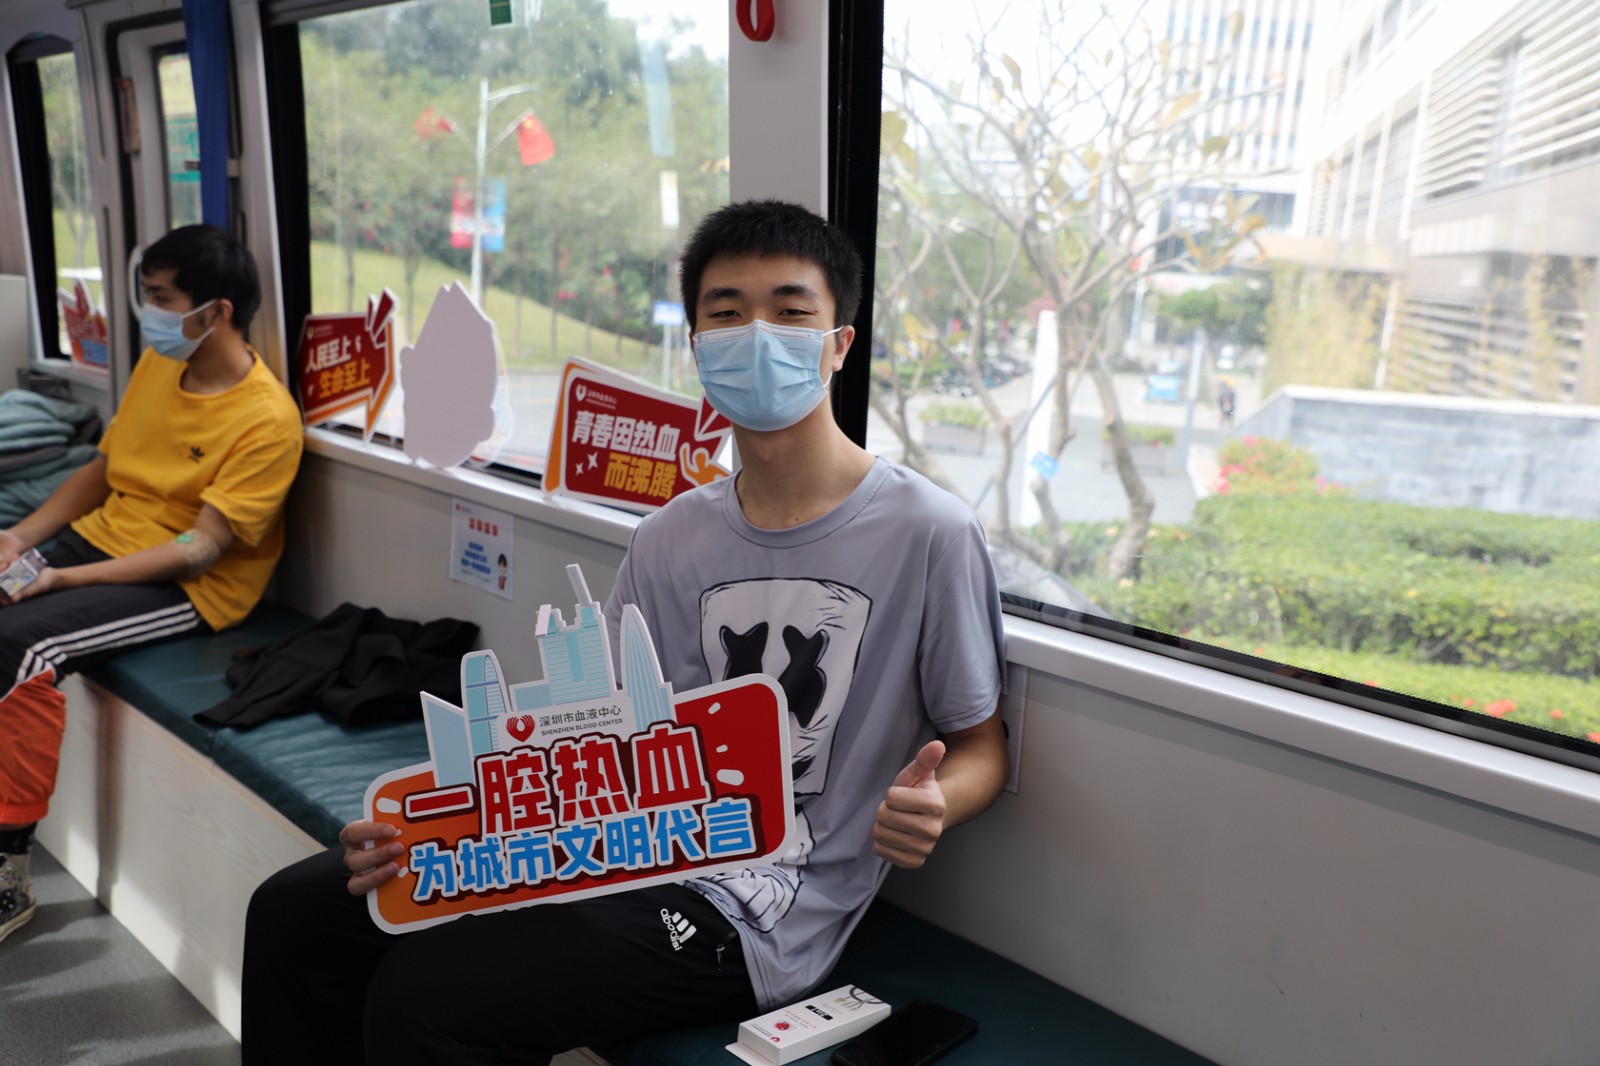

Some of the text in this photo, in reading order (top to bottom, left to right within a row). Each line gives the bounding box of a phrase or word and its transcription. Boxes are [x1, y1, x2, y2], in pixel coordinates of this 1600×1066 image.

[305, 335, 351, 374] 人民至上
[319, 357, 371, 398] 生命至上
[572, 410, 681, 462] 青春因热血
[603, 452, 677, 500] 而沸腾
[539, 705, 622, 727] 深圳市血液中心
[541, 718, 623, 736] SHENZHEN BLOOD CENTER
[403, 722, 711, 837] 一腔热血
[411, 800, 756, 900] 为城市文明代言
